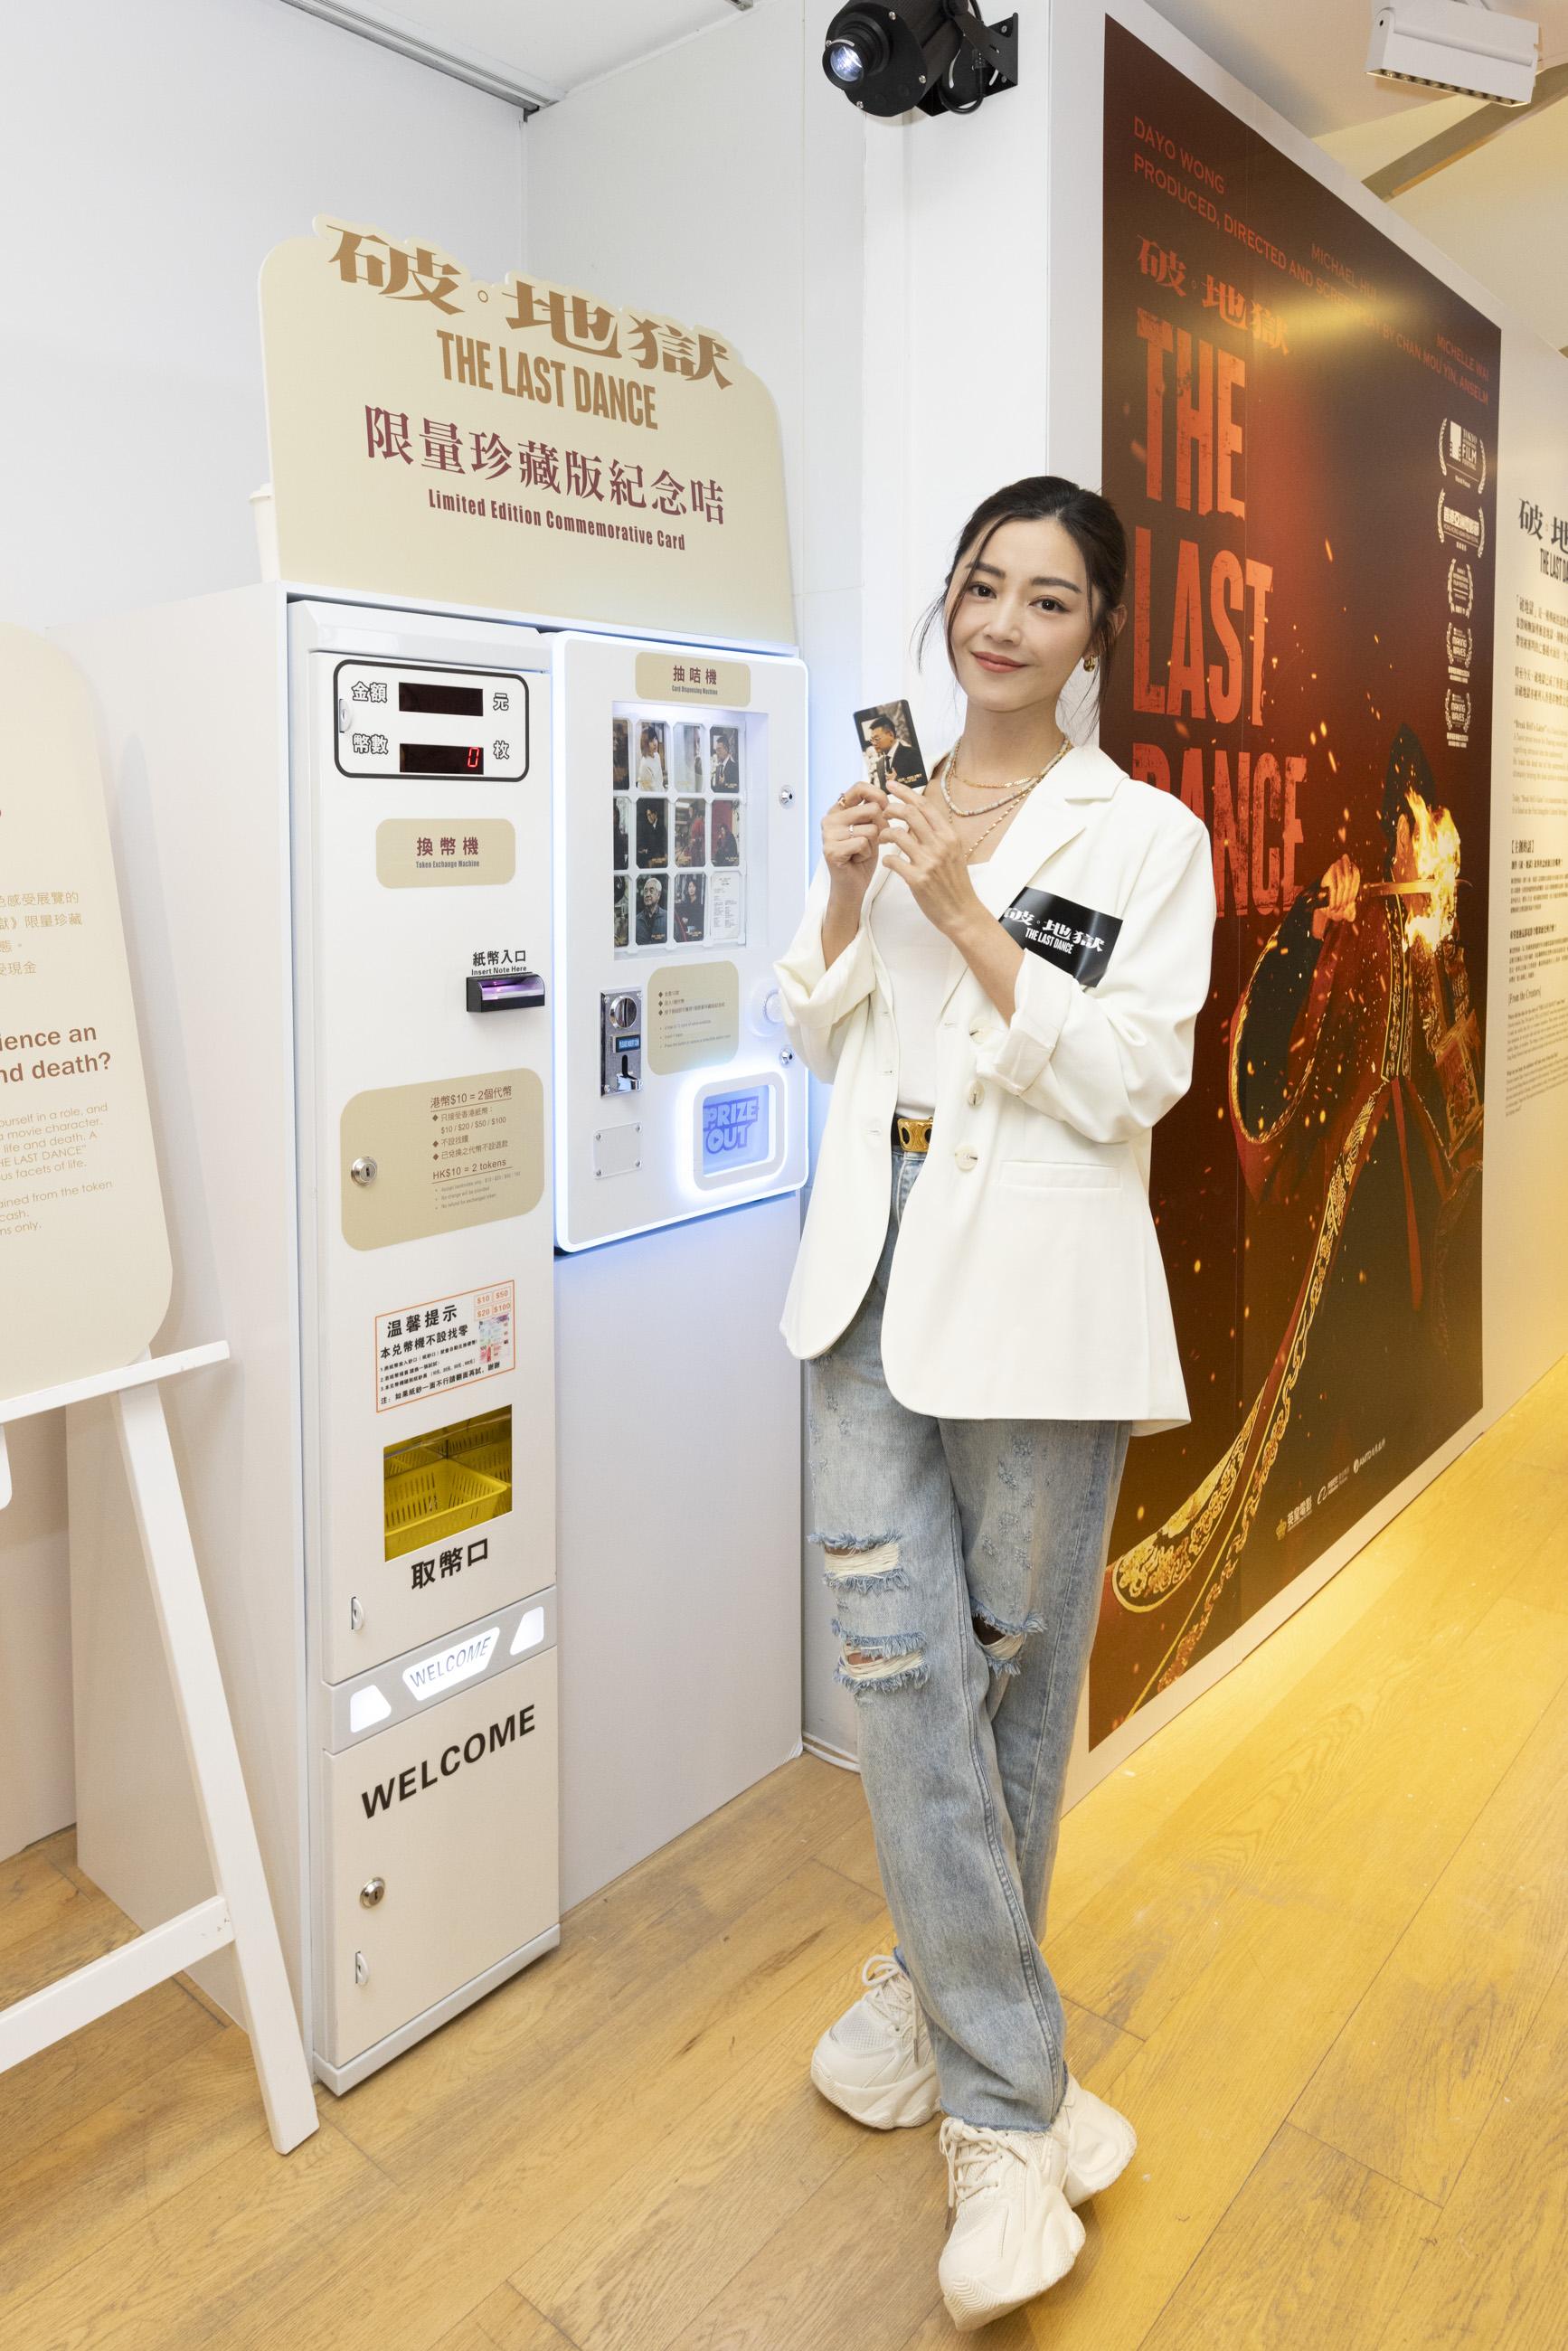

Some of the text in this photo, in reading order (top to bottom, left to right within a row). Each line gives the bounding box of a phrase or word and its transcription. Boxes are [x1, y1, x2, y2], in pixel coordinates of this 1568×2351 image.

[1134, 116, 1225, 195] DAYO WONG
[1133, 152, 1221, 229] PRODUCED,
[1223, 213, 1287, 271] DIRECTED
[1289, 259, 1313, 291] AND
[1383, 325, 1395, 342] BY
[1396, 333, 1422, 361] CHAN
[1423, 352, 1442, 373] MOU
[1460, 375, 1489, 406] ANSELM
[1311, 243, 1376, 300] MICHAEL HUI
[1437, 333, 1489, 382] MICHELLE WAI
[436, 329, 658, 430] THE LAST DANCE
[1137, 307, 1245, 521] THE
[1461, 443, 1477, 464] FILM
[364, 404, 724, 525] 限量珍藏版紀念咭
[429, 489, 685, 551] Limited Edition Commemorative Card
[1540, 548, 1549, 575] THE
[1550, 552, 1562, 581] LAST
[1133, 526, 1273, 726] LAST
[674, 666, 717, 685] 抽咭機
[351, 681, 387, 703] 金額
[493, 693, 509, 711] 元
[352, 733, 388, 754] 幣數
[493, 741, 510, 760] 枚
[468, 747, 480, 768] 0
[417, 836, 479, 856] 換幣機
[416, 860, 479, 869] Token Exchange Machine
[1025, 927, 1074, 954] THE LAST DANCE
[472, 949, 526, 967] 紙幣入口
[471, 965, 527, 976] Insert Note Here
[69, 1027, 97, 1043] an
[33, 1052, 111, 1079] death?
[430, 1093, 468, 1109] 港幣$10
[477, 1085, 512, 1100] 2個代幣
[36, 1113, 46, 1122] in
[87, 1102, 108, 1114] and
[704, 1096, 759, 1129] PRIZE
[7, 1127, 43, 1139] movie
[45, 1119, 103, 1133] character.
[441, 1125, 452, 1135] $10
[458, 1122, 470, 1131] $20
[475, 1119, 486, 1128] $50
[492, 1117, 506, 1126] $100
[4, 1143, 20, 1154] life
[24, 1138, 46, 1150] and
[90, 1129, 98, 1140] A
[706, 1125, 750, 1153] OUT
[14, 1153, 38, 1166] LAST
[15, 1165, 52, 1179] facets
[54, 1160, 65, 1171] of
[68, 1159, 87, 1169] life.
[433, 1166, 461, 1180] HK$10
[472, 1164, 477, 1172] 2
[480, 1159, 506, 1171] tokens
[33, 1191, 58, 1202] from
[61, 1186, 80, 1196] the
[82, 1181, 113, 1193] token
[14, 1222, 42, 1233] only.
[477, 1296, 490, 1305] $10
[496, 1289, 508, 1299] $50
[477, 1308, 490, 1317] $20
[494, 1303, 511, 1313] $100
[411, 1538, 488, 1590] 取幣口
[410, 1636, 491, 1688] WELCOME
[361, 1704, 535, 1819] WELCOME
